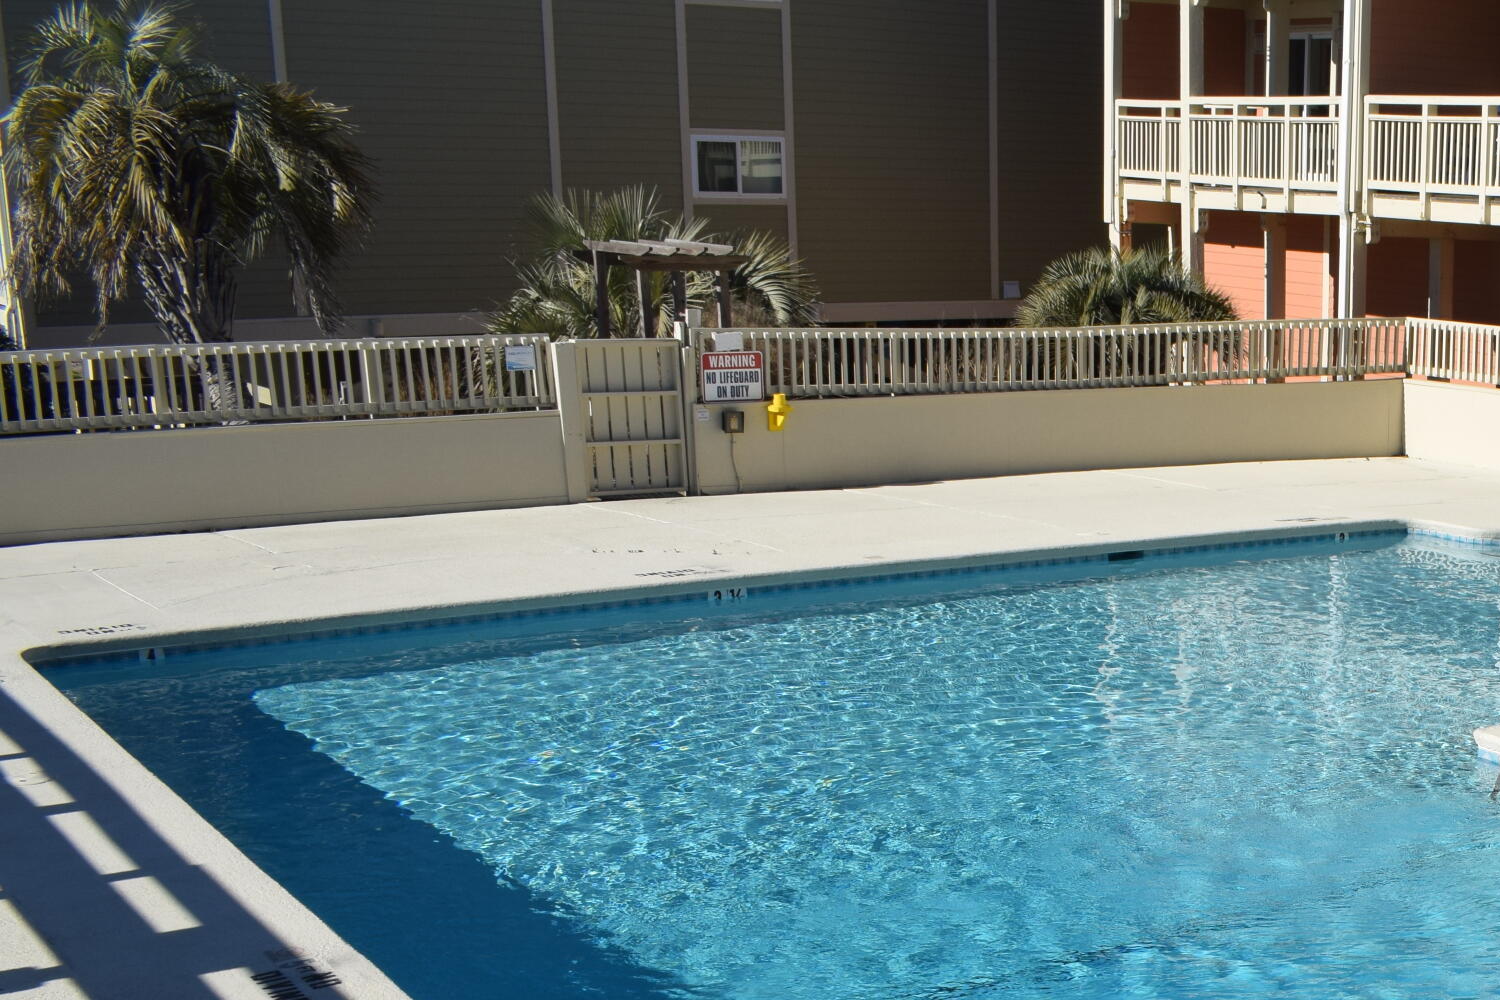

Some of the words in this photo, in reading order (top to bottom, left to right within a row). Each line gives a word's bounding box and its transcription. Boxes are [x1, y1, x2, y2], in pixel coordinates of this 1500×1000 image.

[709, 354, 756, 368] WARNING
[706, 372, 717, 384] NO
[720, 371, 760, 384] LIFEGUARD
[717, 385, 728, 398] ON
[730, 385, 750, 397] DUTY
[301, 971, 343, 990] NO
